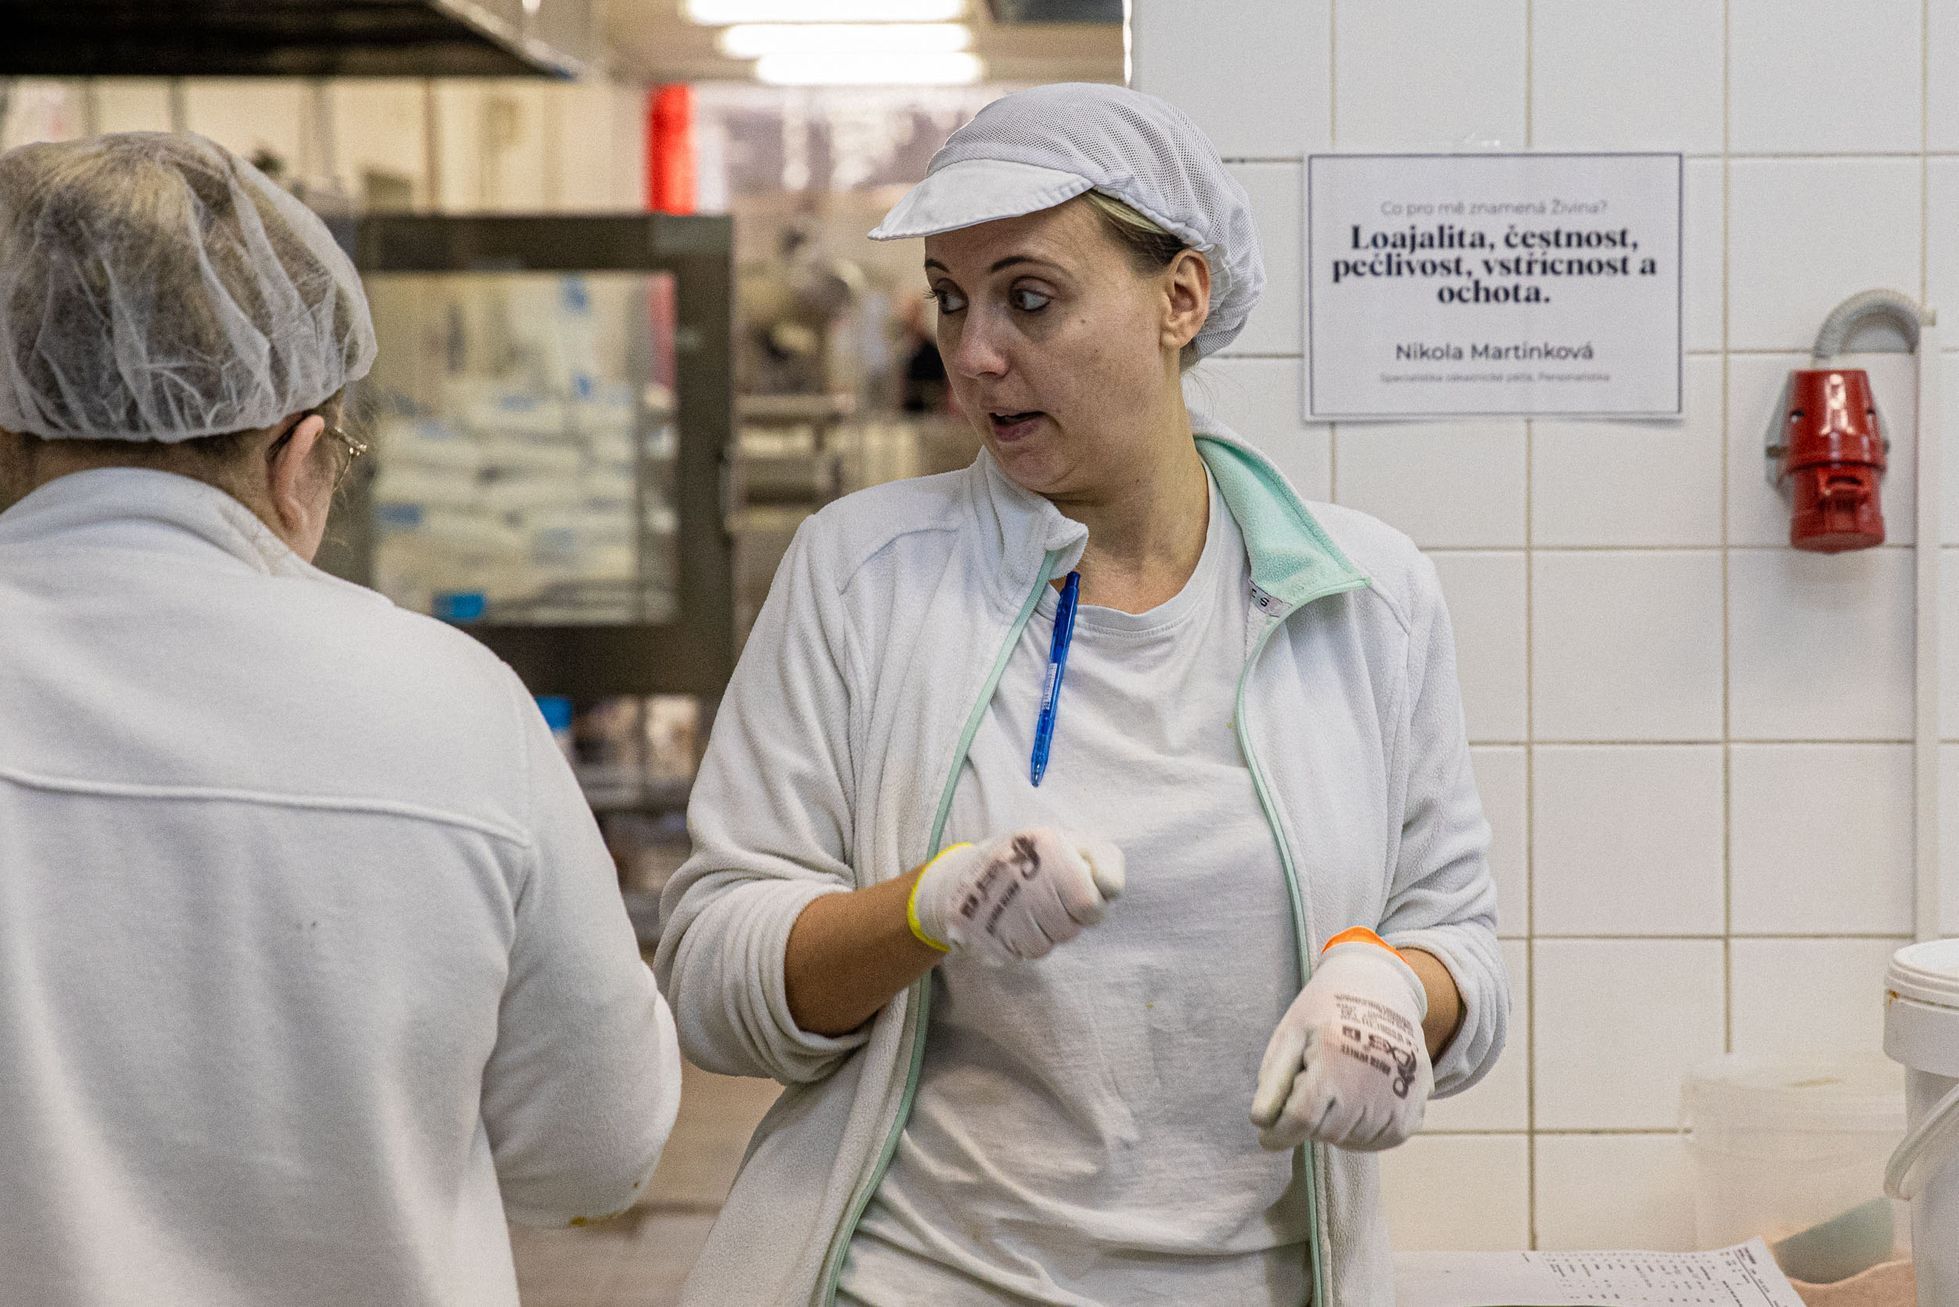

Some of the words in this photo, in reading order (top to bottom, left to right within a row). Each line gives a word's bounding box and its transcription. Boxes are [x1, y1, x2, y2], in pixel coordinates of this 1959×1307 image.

[1380, 201, 1403, 216] Co
[1406, 204, 1434, 218] pro
[1438, 201, 1465, 216] mě
[1469, 200, 1547, 216] znamená
[1551, 198, 1608, 215] Živina?
[1351, 224, 1495, 253] Loajalita,
[1504, 224, 1638, 251] čestnost,
[1332, 252, 1473, 284] pečlivost,
[1482, 251, 1629, 277] vstřícnost
[1639, 258, 1657, 275] a
[1437, 279, 1551, 304] ochota.
[1396, 342, 1463, 361] Nikola
[1470, 341, 1594, 361] Martinková
[1259, 597, 1270, 607] S
